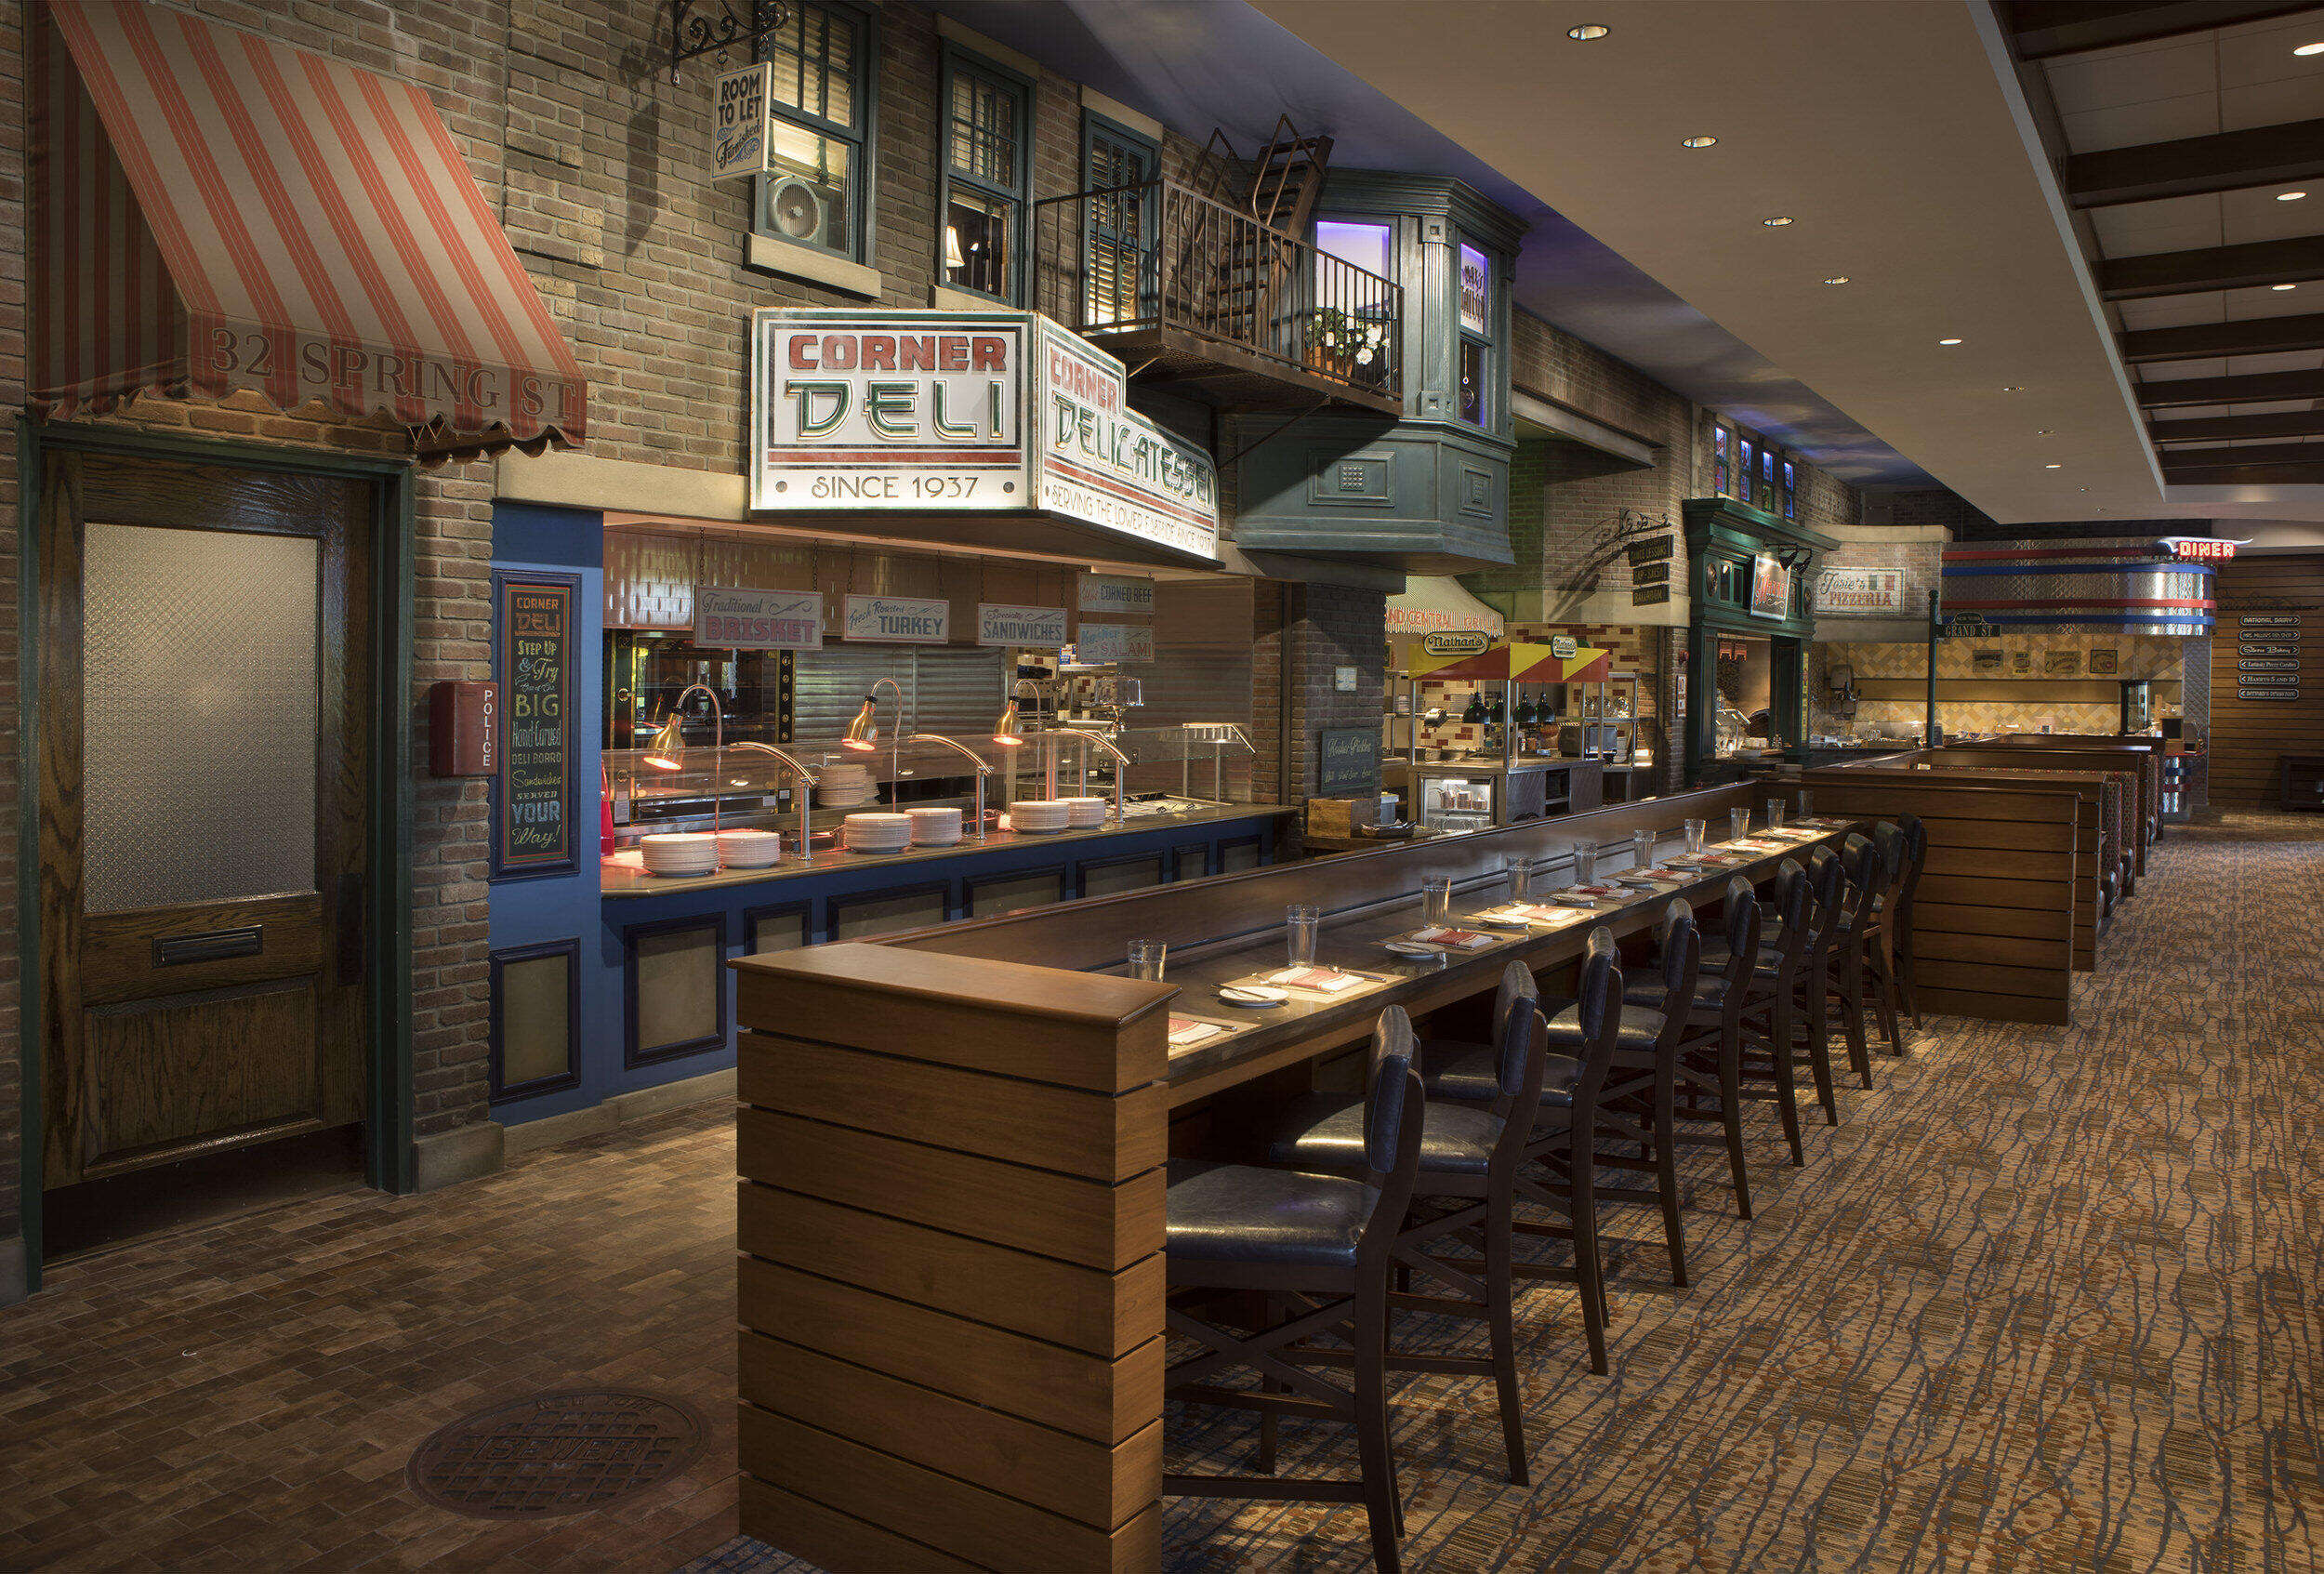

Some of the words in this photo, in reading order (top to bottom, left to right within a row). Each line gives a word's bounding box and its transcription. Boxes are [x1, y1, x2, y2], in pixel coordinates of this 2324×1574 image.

[721, 73, 760, 103] ROOM
[719, 102, 734, 126] TO
[740, 96, 761, 121] LET
[788, 335, 1007, 372] CORNER
[210, 328, 273, 377] 32
[301, 341, 500, 410] SPRING
[521, 377, 576, 422] ST
[1050, 347, 1117, 415] CORNER
[786, 379, 1004, 440] DELI
[1051, 390, 1218, 511] DELICATESSEN
[812, 476, 899, 498] SINCE
[912, 476, 979, 498] 1937
[1051, 484, 1093, 516] SERVING
[1096, 499, 1112, 522] THE
[1115, 505, 1143, 534] LOWER
[2179, 541, 2235, 557] DINER
[516, 597, 559, 610] CORNER
[701, 592, 763, 614] Traditional
[1101, 585, 1131, 602] CORNED
[1133, 587, 1153, 603] BEEF
[1829, 591, 1893, 606] PIZZERIA
[514, 613, 561, 631] DELI
[848, 602, 871, 631] Fresh
[878, 615, 944, 635] TURKEY
[705, 615, 816, 643] BRISKET
[984, 620, 1063, 642] SANDWICHES
[1945, 625, 1975, 637] GRAND
[1981, 625, 1993, 637] ST
[518, 640, 542, 655] STEP
[545, 640, 558, 655] UP
[1101, 642, 1152, 657] SALAMI
[1428, 634, 1485, 648] Nathan's
[519, 657, 534, 672] &
[533, 656, 559, 683] Try
[515, 694, 559, 717] BIG
[483, 690, 494, 767] POLICE
[512, 753, 531, 764] DELI
[534, 751, 561, 764] BOARD
[512, 770, 561, 788] Sandwiches
[517, 790, 558, 800] SERVED
[511, 800, 561, 824] YOUR
[511, 824, 561, 849] Way!
[486, 1437, 640, 1461] SEWER
